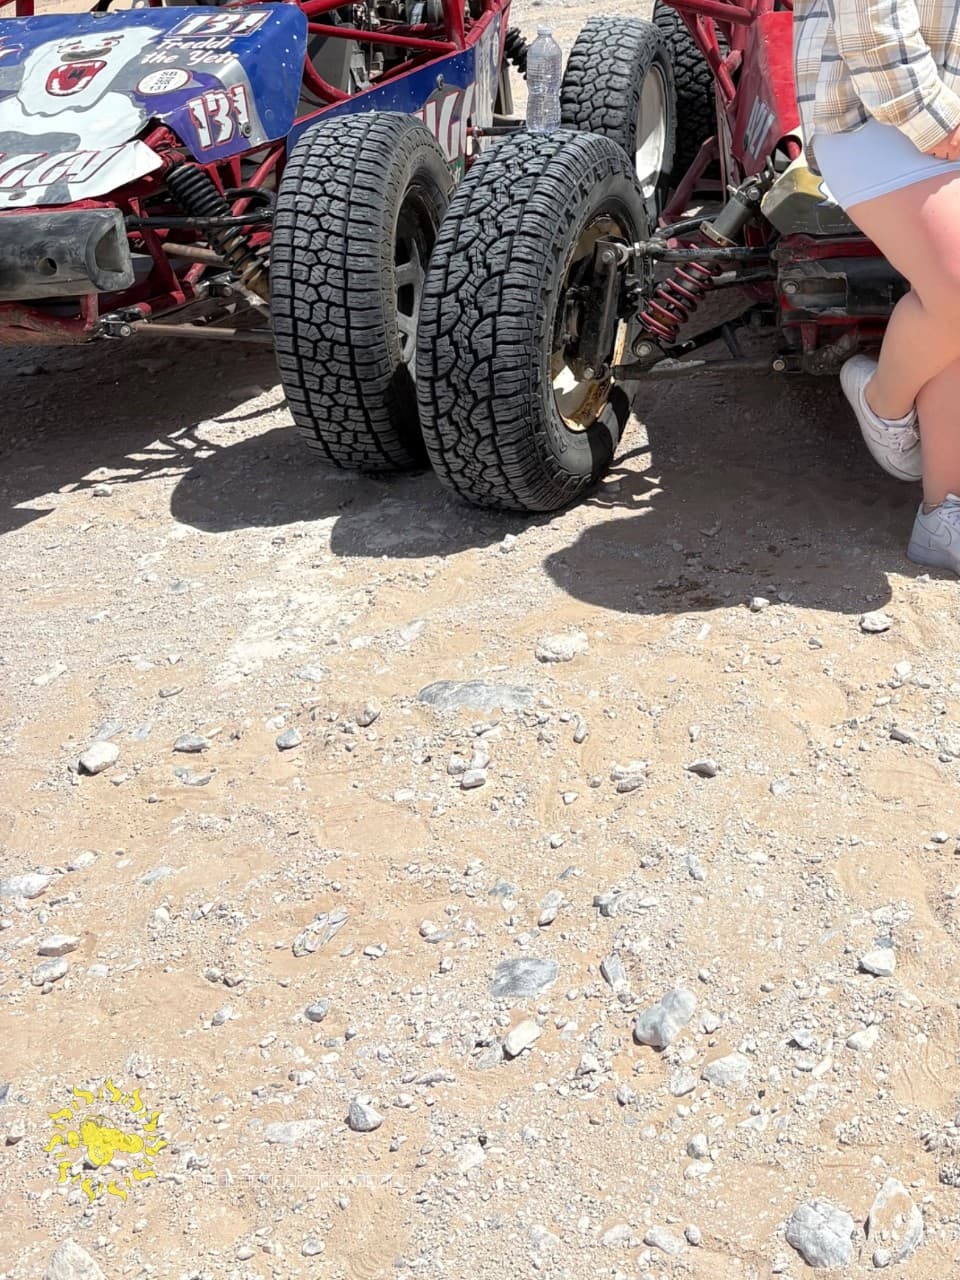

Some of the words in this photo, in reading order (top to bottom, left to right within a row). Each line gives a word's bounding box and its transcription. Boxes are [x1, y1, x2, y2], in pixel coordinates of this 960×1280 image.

[173, 10, 270, 36] 131
[140, 51, 179, 64] the
[187, 84, 251, 151] 131
